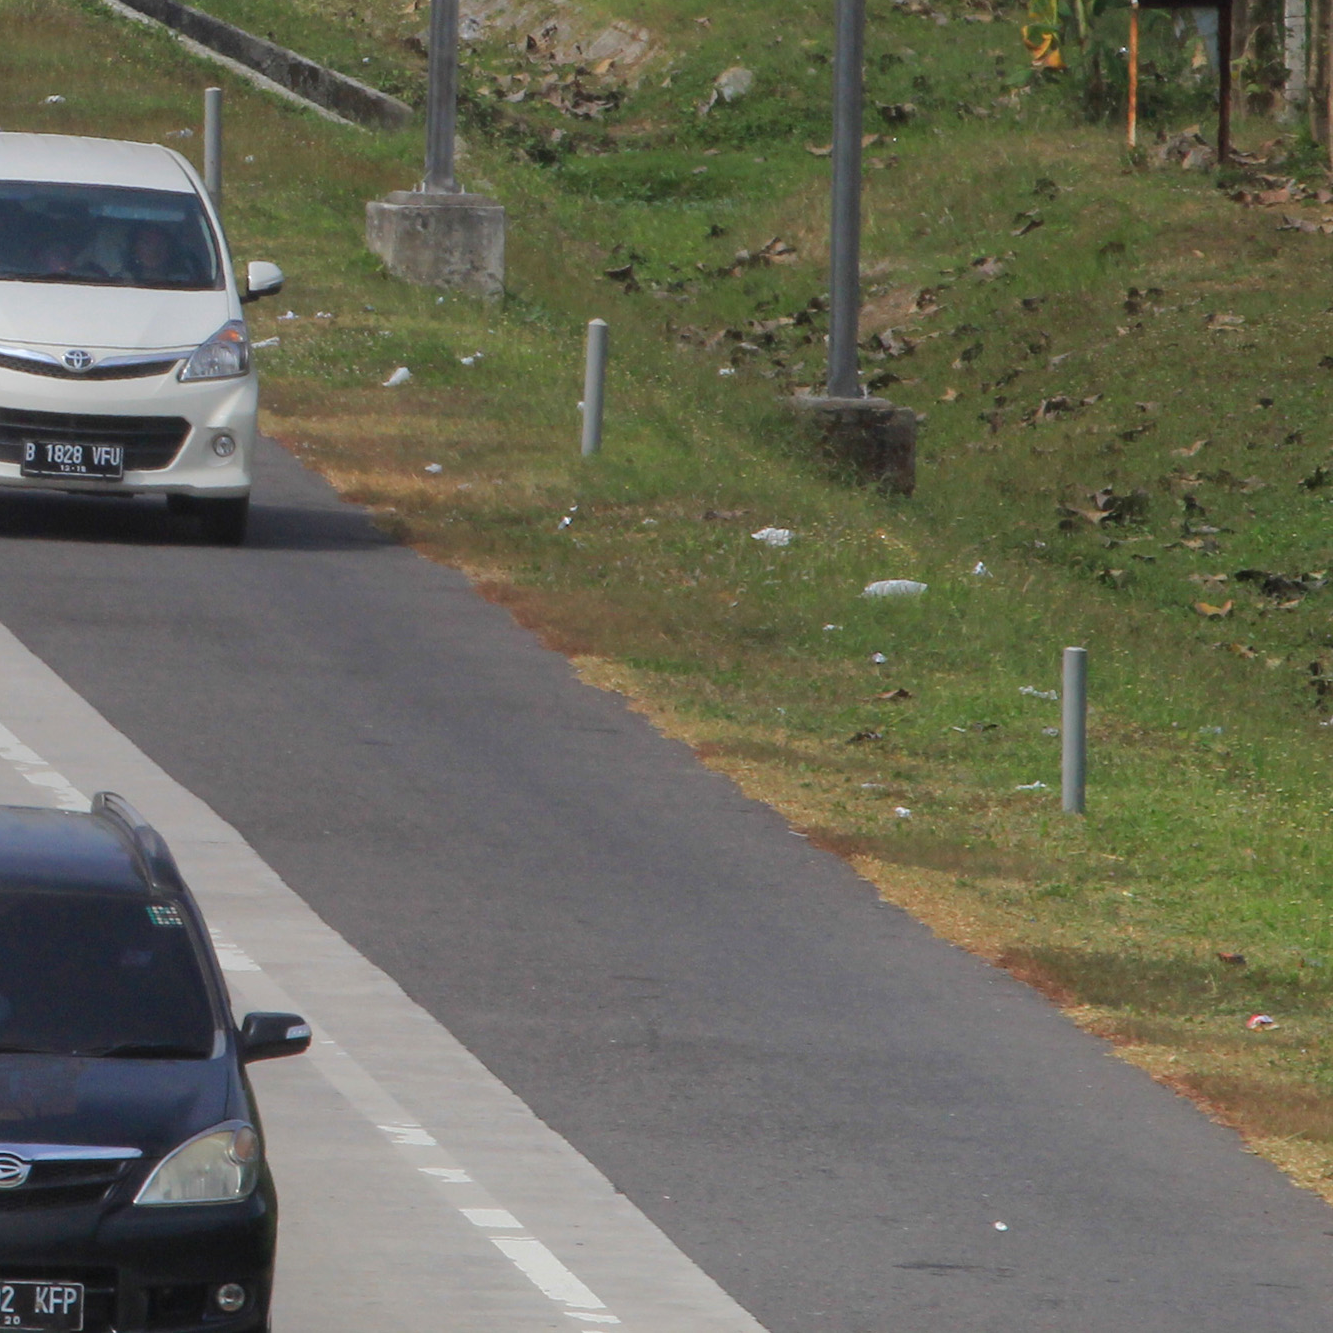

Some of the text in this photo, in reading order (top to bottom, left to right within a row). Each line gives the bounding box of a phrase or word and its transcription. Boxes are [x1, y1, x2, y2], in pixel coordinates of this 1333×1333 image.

[25, 442, 120, 465] B 1828 VFU
[35, 1286, 77, 1314] KFP
